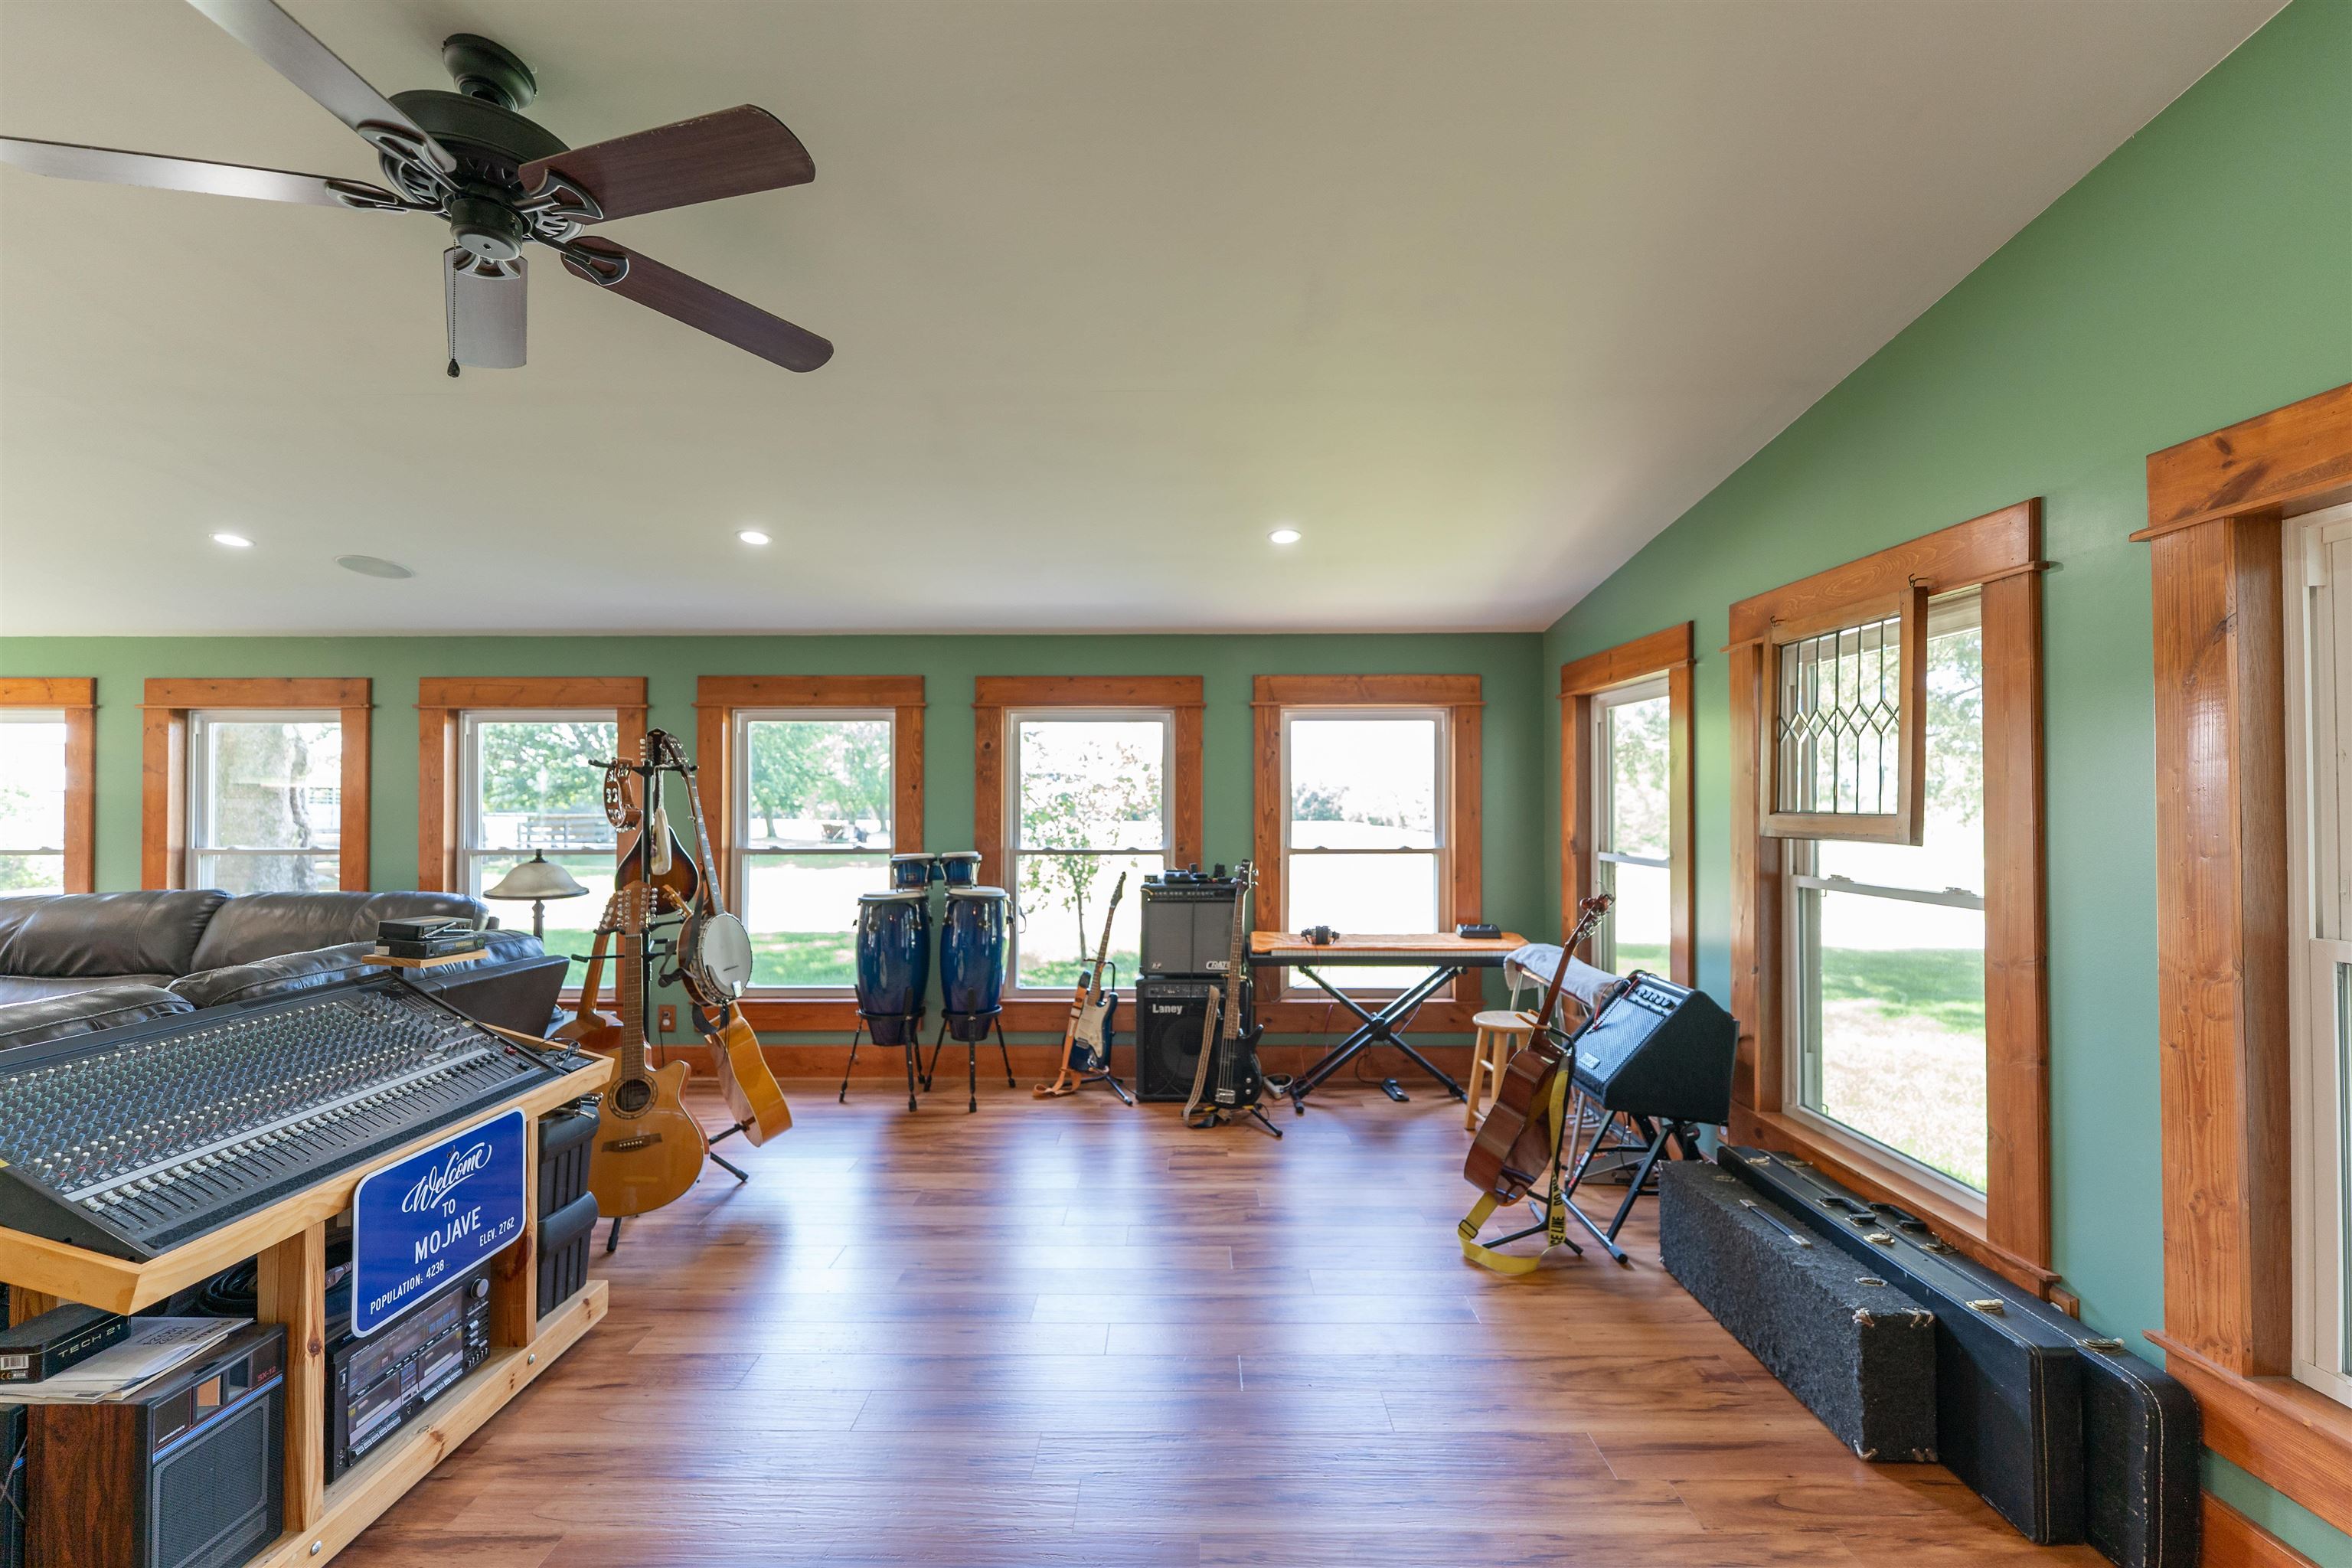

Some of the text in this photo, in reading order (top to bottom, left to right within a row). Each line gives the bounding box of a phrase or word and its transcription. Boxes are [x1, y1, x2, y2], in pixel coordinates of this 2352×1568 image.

[1152, 1004, 1183, 1014] Laney
[401, 1142, 492, 1214] Welcome
[442, 1198, 456, 1217] TO
[1553, 1193, 1563, 1206] DO
[415, 1206, 481, 1264] MOJAVE
[479, 1217, 514, 1247] ELEV. 2762
[1551, 1216, 1565, 1233] LINE
[370, 1259, 445, 1315] POPULATION: 4238
[58, 1324, 121, 1357] TECH 21
[257, 1366, 276, 1382] SX-12
